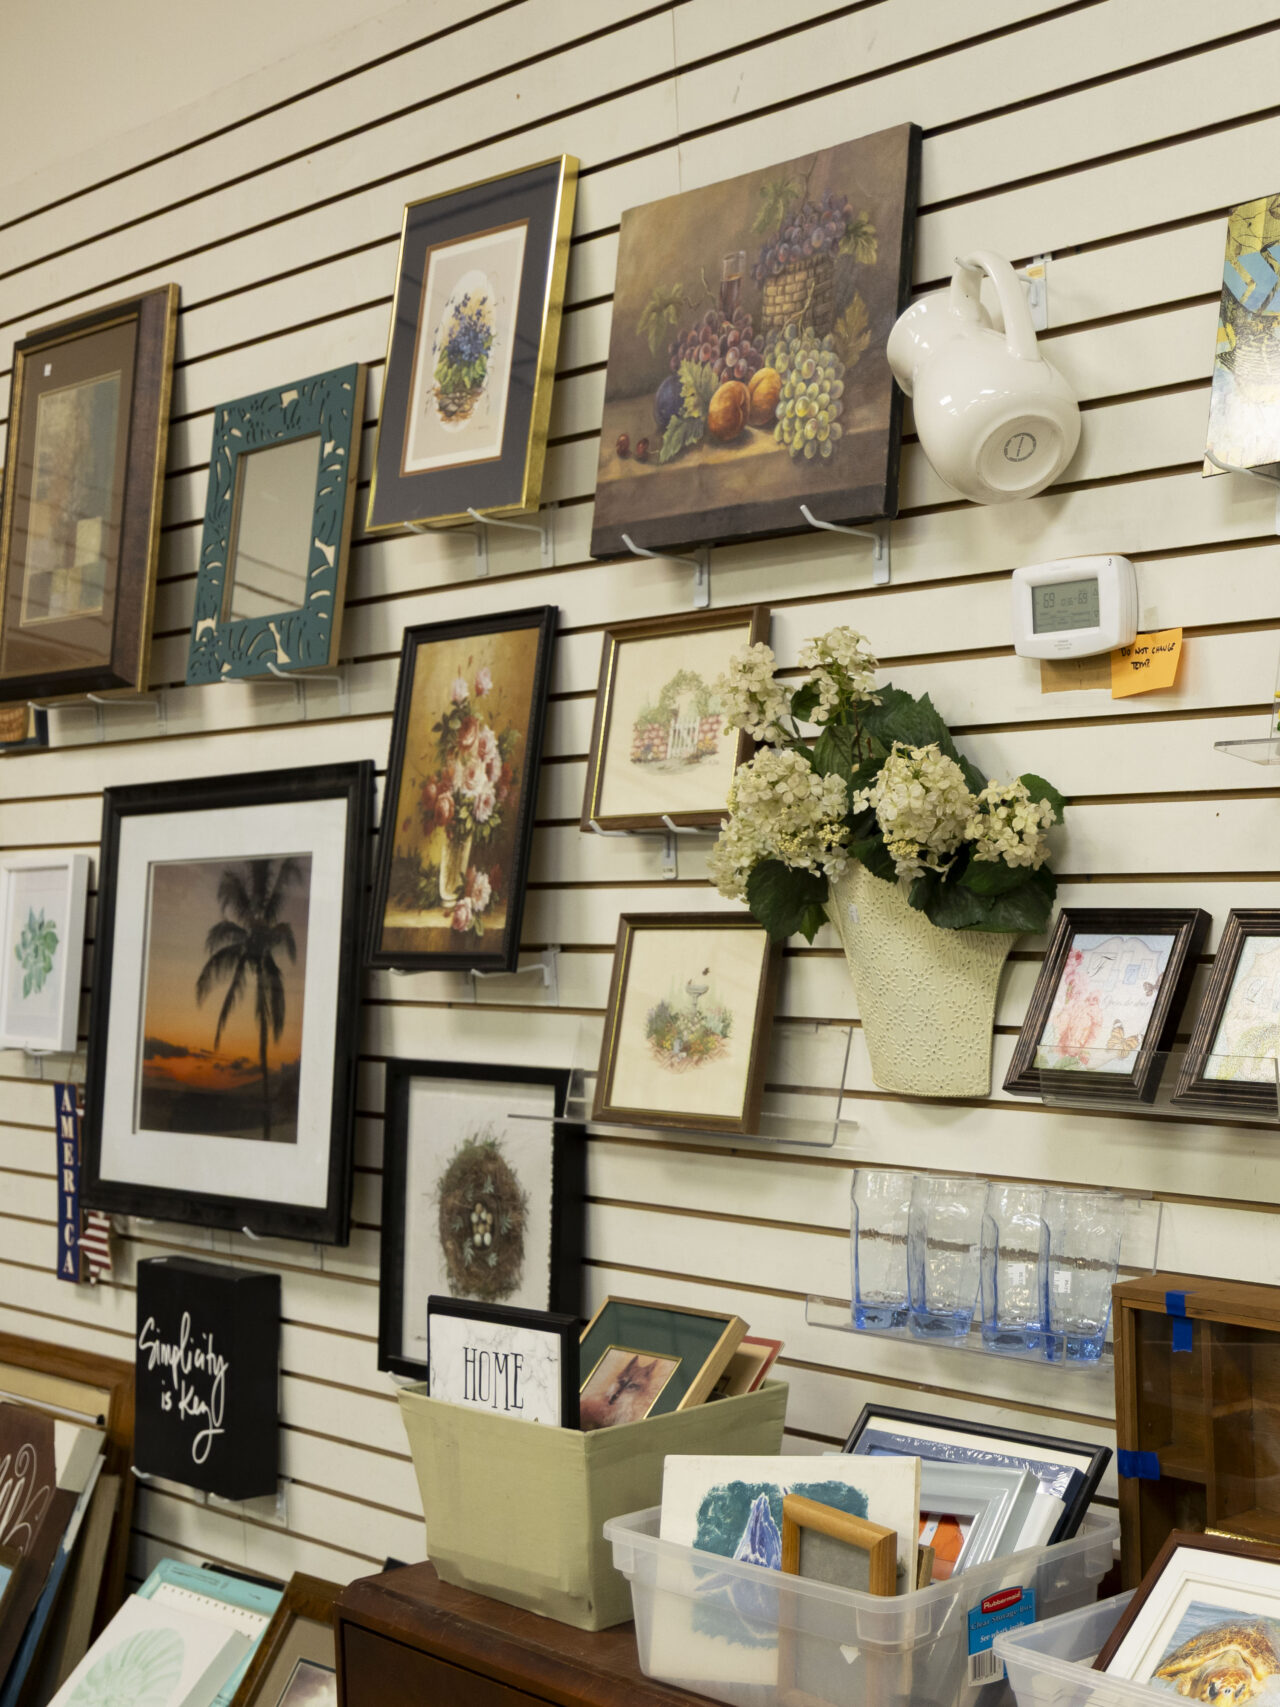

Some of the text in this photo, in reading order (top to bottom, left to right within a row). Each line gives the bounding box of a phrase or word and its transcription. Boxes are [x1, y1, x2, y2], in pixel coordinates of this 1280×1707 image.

[1120, 642, 1176, 657] DO NOT CHANGE
[60, 1087, 77, 1276] AMERICA
[138, 1311, 230, 1428] Simplicity
[463, 1346, 525, 1411] HOME
[161, 1379, 226, 1464] is Key
[983, 1590, 1021, 1610] Rubbermaid
[980, 1634, 990, 1643] See
